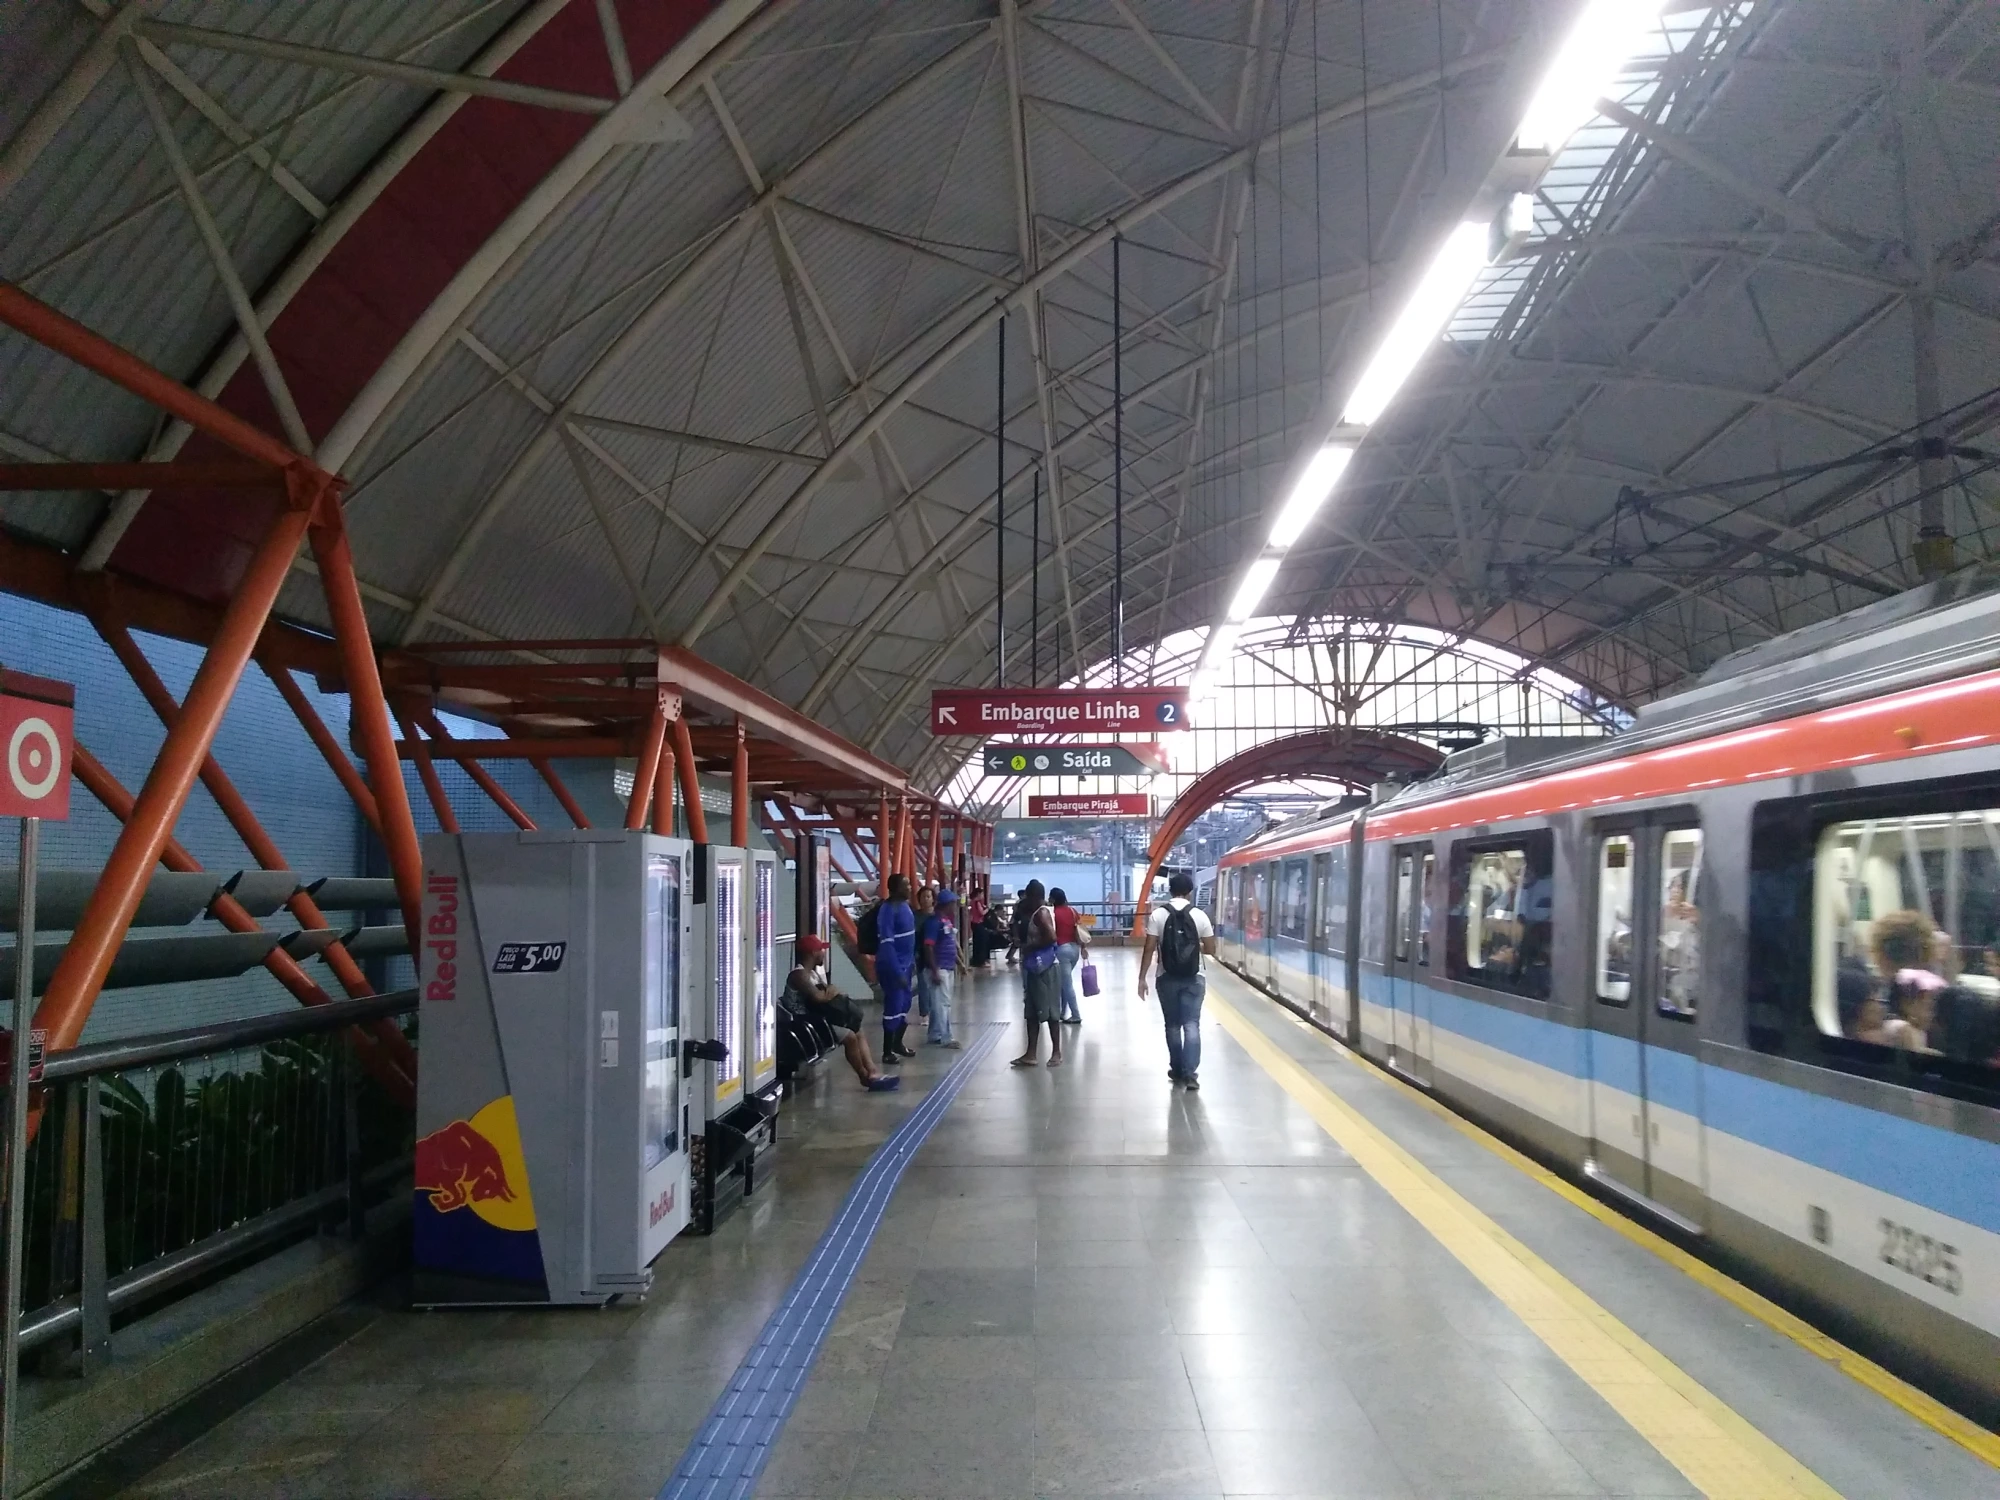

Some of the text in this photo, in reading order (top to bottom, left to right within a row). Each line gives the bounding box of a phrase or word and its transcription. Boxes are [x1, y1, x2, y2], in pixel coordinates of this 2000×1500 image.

[981, 700, 1176, 725] Embarque Linha 2
[1016, 722, 1045, 730] Boarding
[1063, 751, 1112, 768] Saída
[1043, 801, 1089, 812] Embarque
[1091, 800, 1119, 811] Pirajá
[426, 876, 460, 1001] Red Bull
[498, 953, 517, 962] LATA
[521, 945, 562, 971] 5,00
